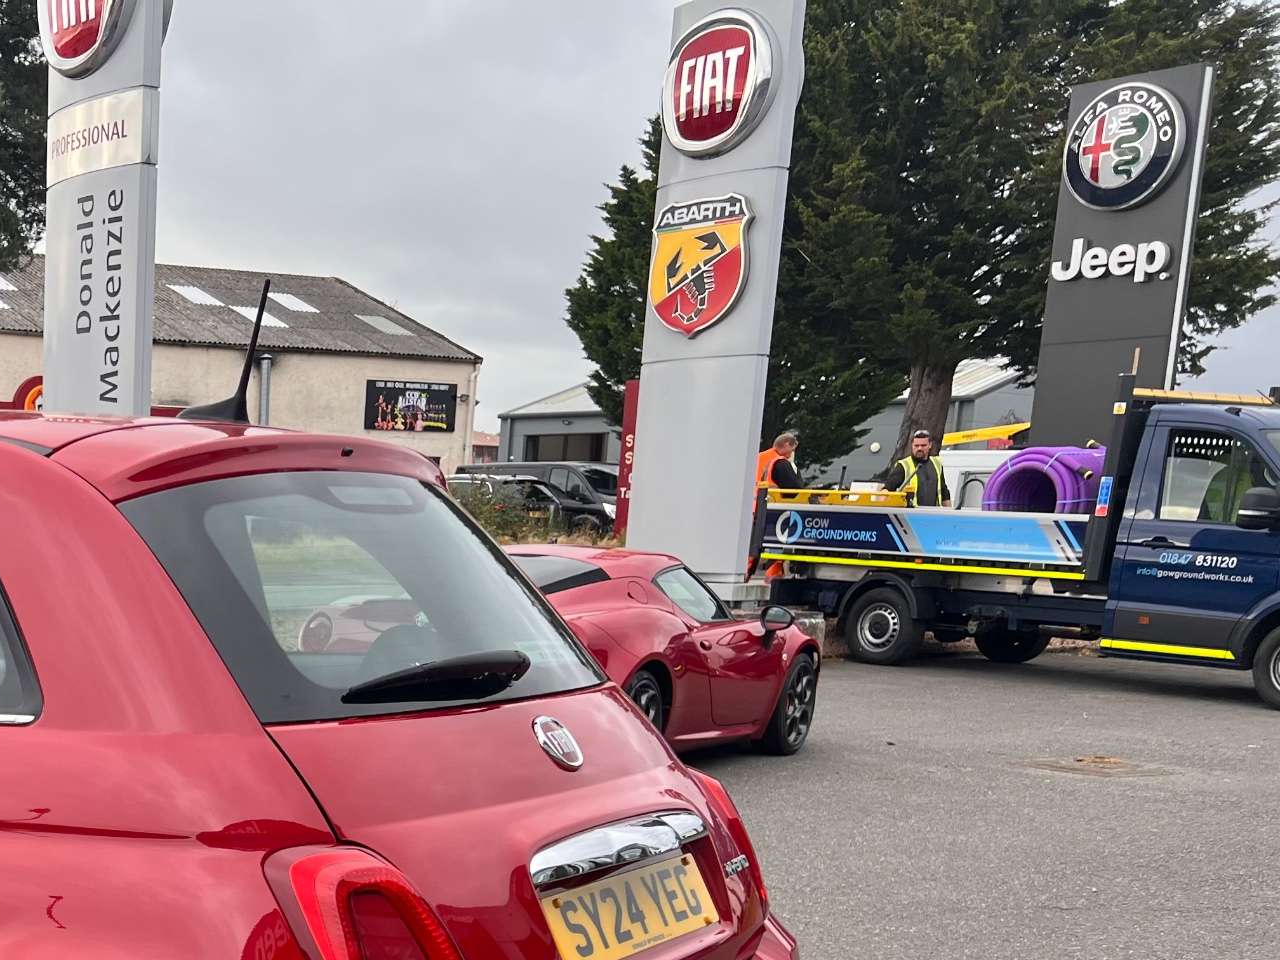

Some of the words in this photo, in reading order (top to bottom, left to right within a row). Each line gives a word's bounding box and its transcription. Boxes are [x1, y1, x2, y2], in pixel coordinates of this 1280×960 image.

[679, 46, 745, 121] FIAT
[51, 120, 128, 160] PROFESSIONAL
[1071, 101, 1108, 153] ALFA
[1118, 90, 1172, 142] ROMEO
[660, 202, 741, 226] ABARTH
[75, 194, 95, 335] Donald
[99, 189, 124, 404] Mackenzie
[803, 527, 878, 542] GROUNDWORKS
[805, 517, 830, 529] GOW
[1136, 567, 1254, 584] info@gowgroundworks.co.uk
[1159, 552, 1193, 565] 01847
[1195, 554, 1238, 569] 831120
[559, 880, 649, 958] SY24
[640, 865, 703, 928] YEG
